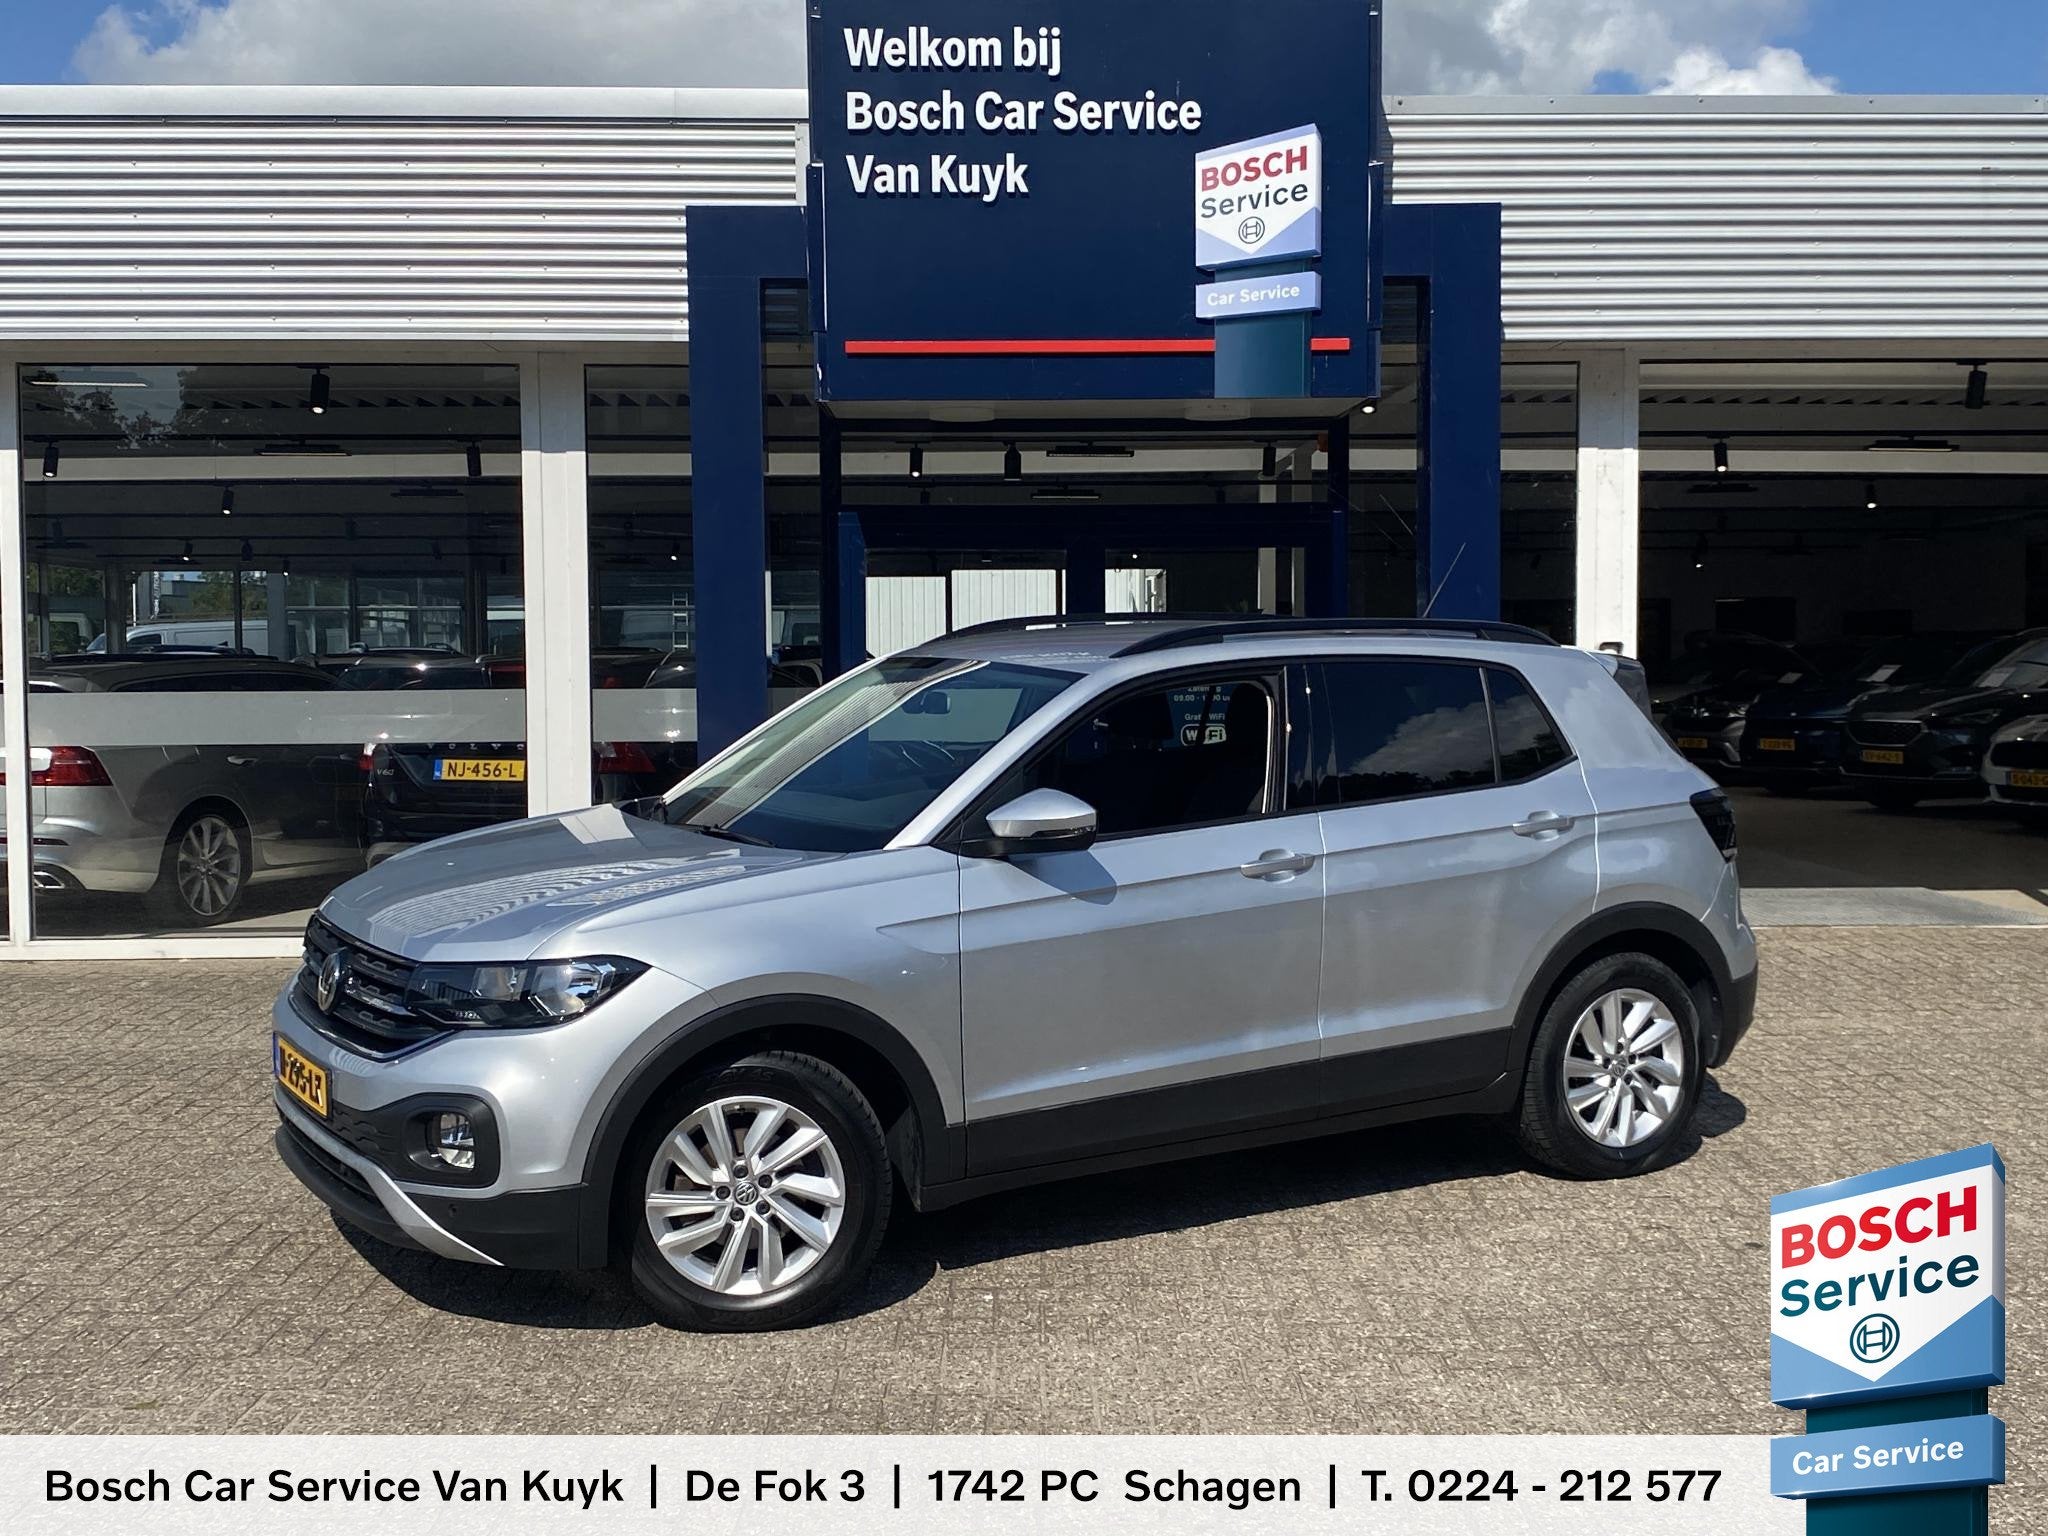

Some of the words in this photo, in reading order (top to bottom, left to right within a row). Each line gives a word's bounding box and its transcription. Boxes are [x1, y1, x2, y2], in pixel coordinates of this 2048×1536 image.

[843, 26, 1002, 67] Welkom
[1013, 26, 1061, 77] bij
[846, 89, 965, 131] Bosch
[975, 91, 1045, 131] Car
[1053, 89, 1202, 131] Service
[845, 154, 920, 193] Van
[930, 152, 1030, 203] Kuyk
[1201, 145, 1308, 193] BOSCH
[1200, 183, 1309, 219] Service
[1206, 292, 1236, 307] Car
[1239, 284, 1300, 304] Service
[1185, 713, 1202, 721] Grat
[447, 762, 518, 778] NJ-456-L
